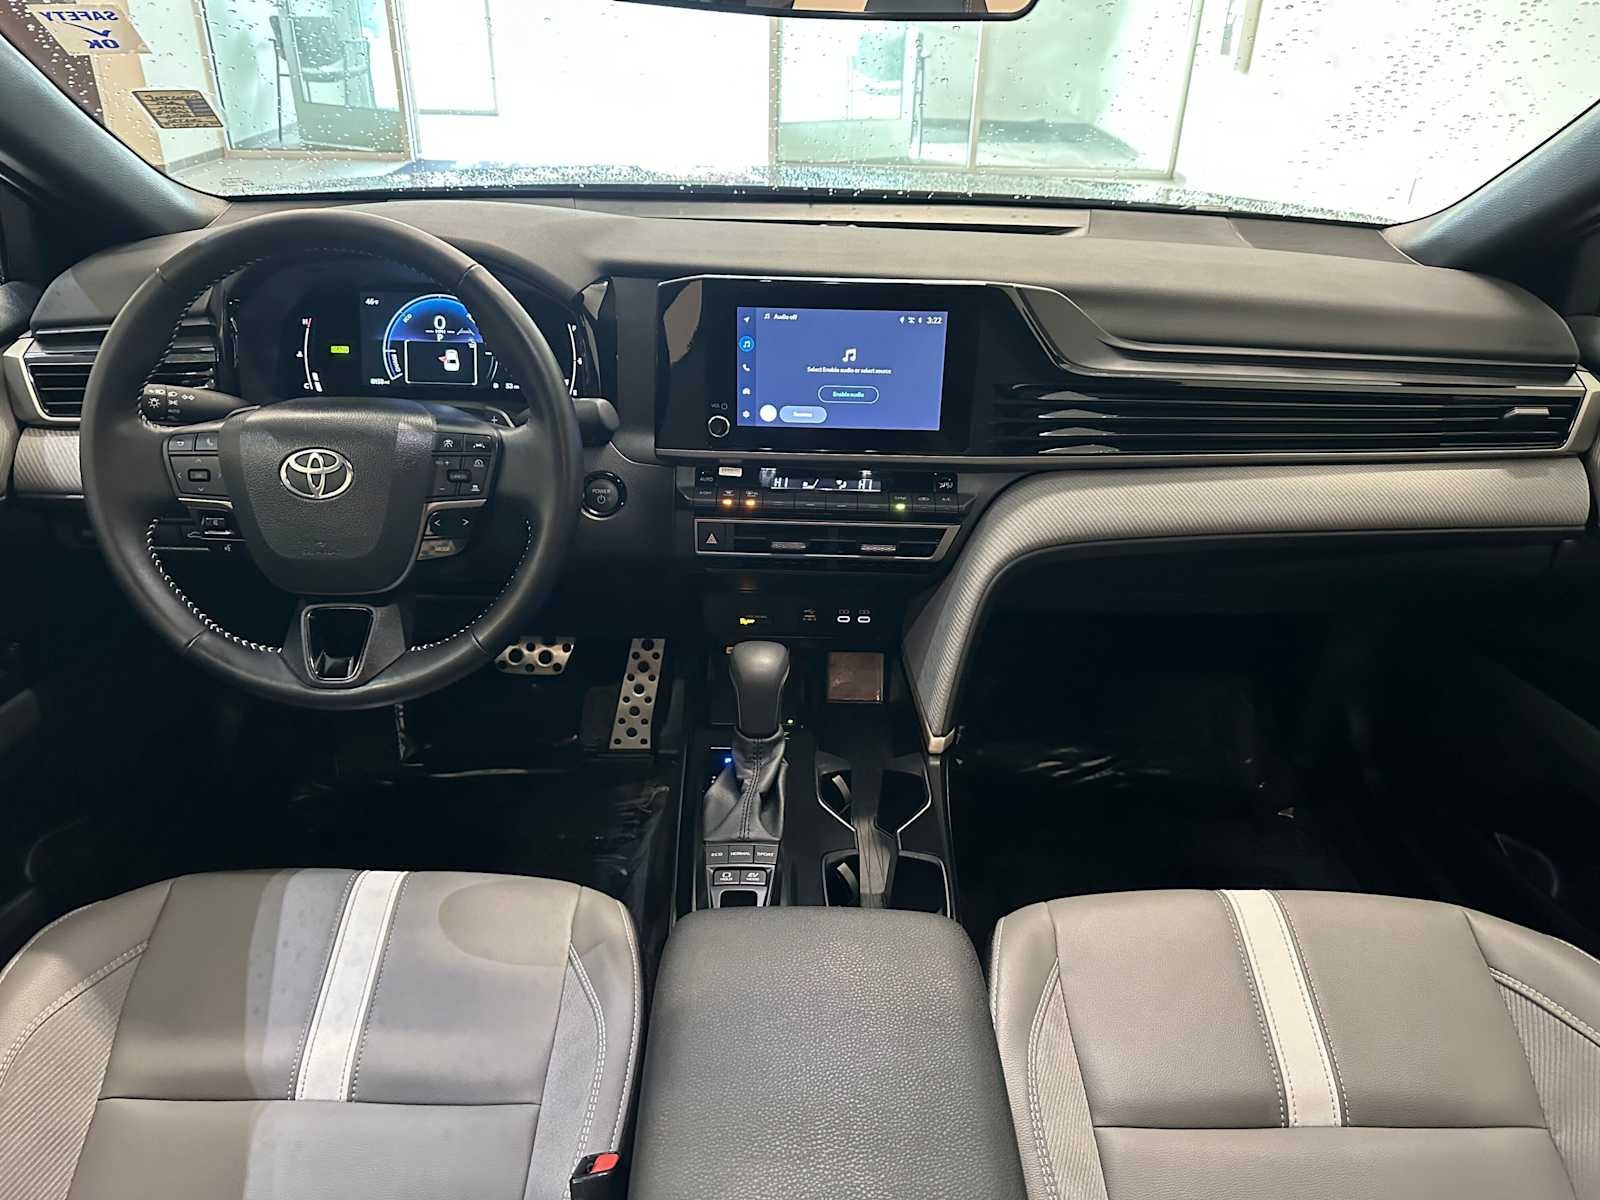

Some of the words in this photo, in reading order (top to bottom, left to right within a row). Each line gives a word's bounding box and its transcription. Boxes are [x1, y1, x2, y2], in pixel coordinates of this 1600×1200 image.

[773, 313, 789, 321] Audio
[926, 316, 943, 325] 3:22
[436, 333, 444, 342] P
[774, 477, 789, 489] HI
